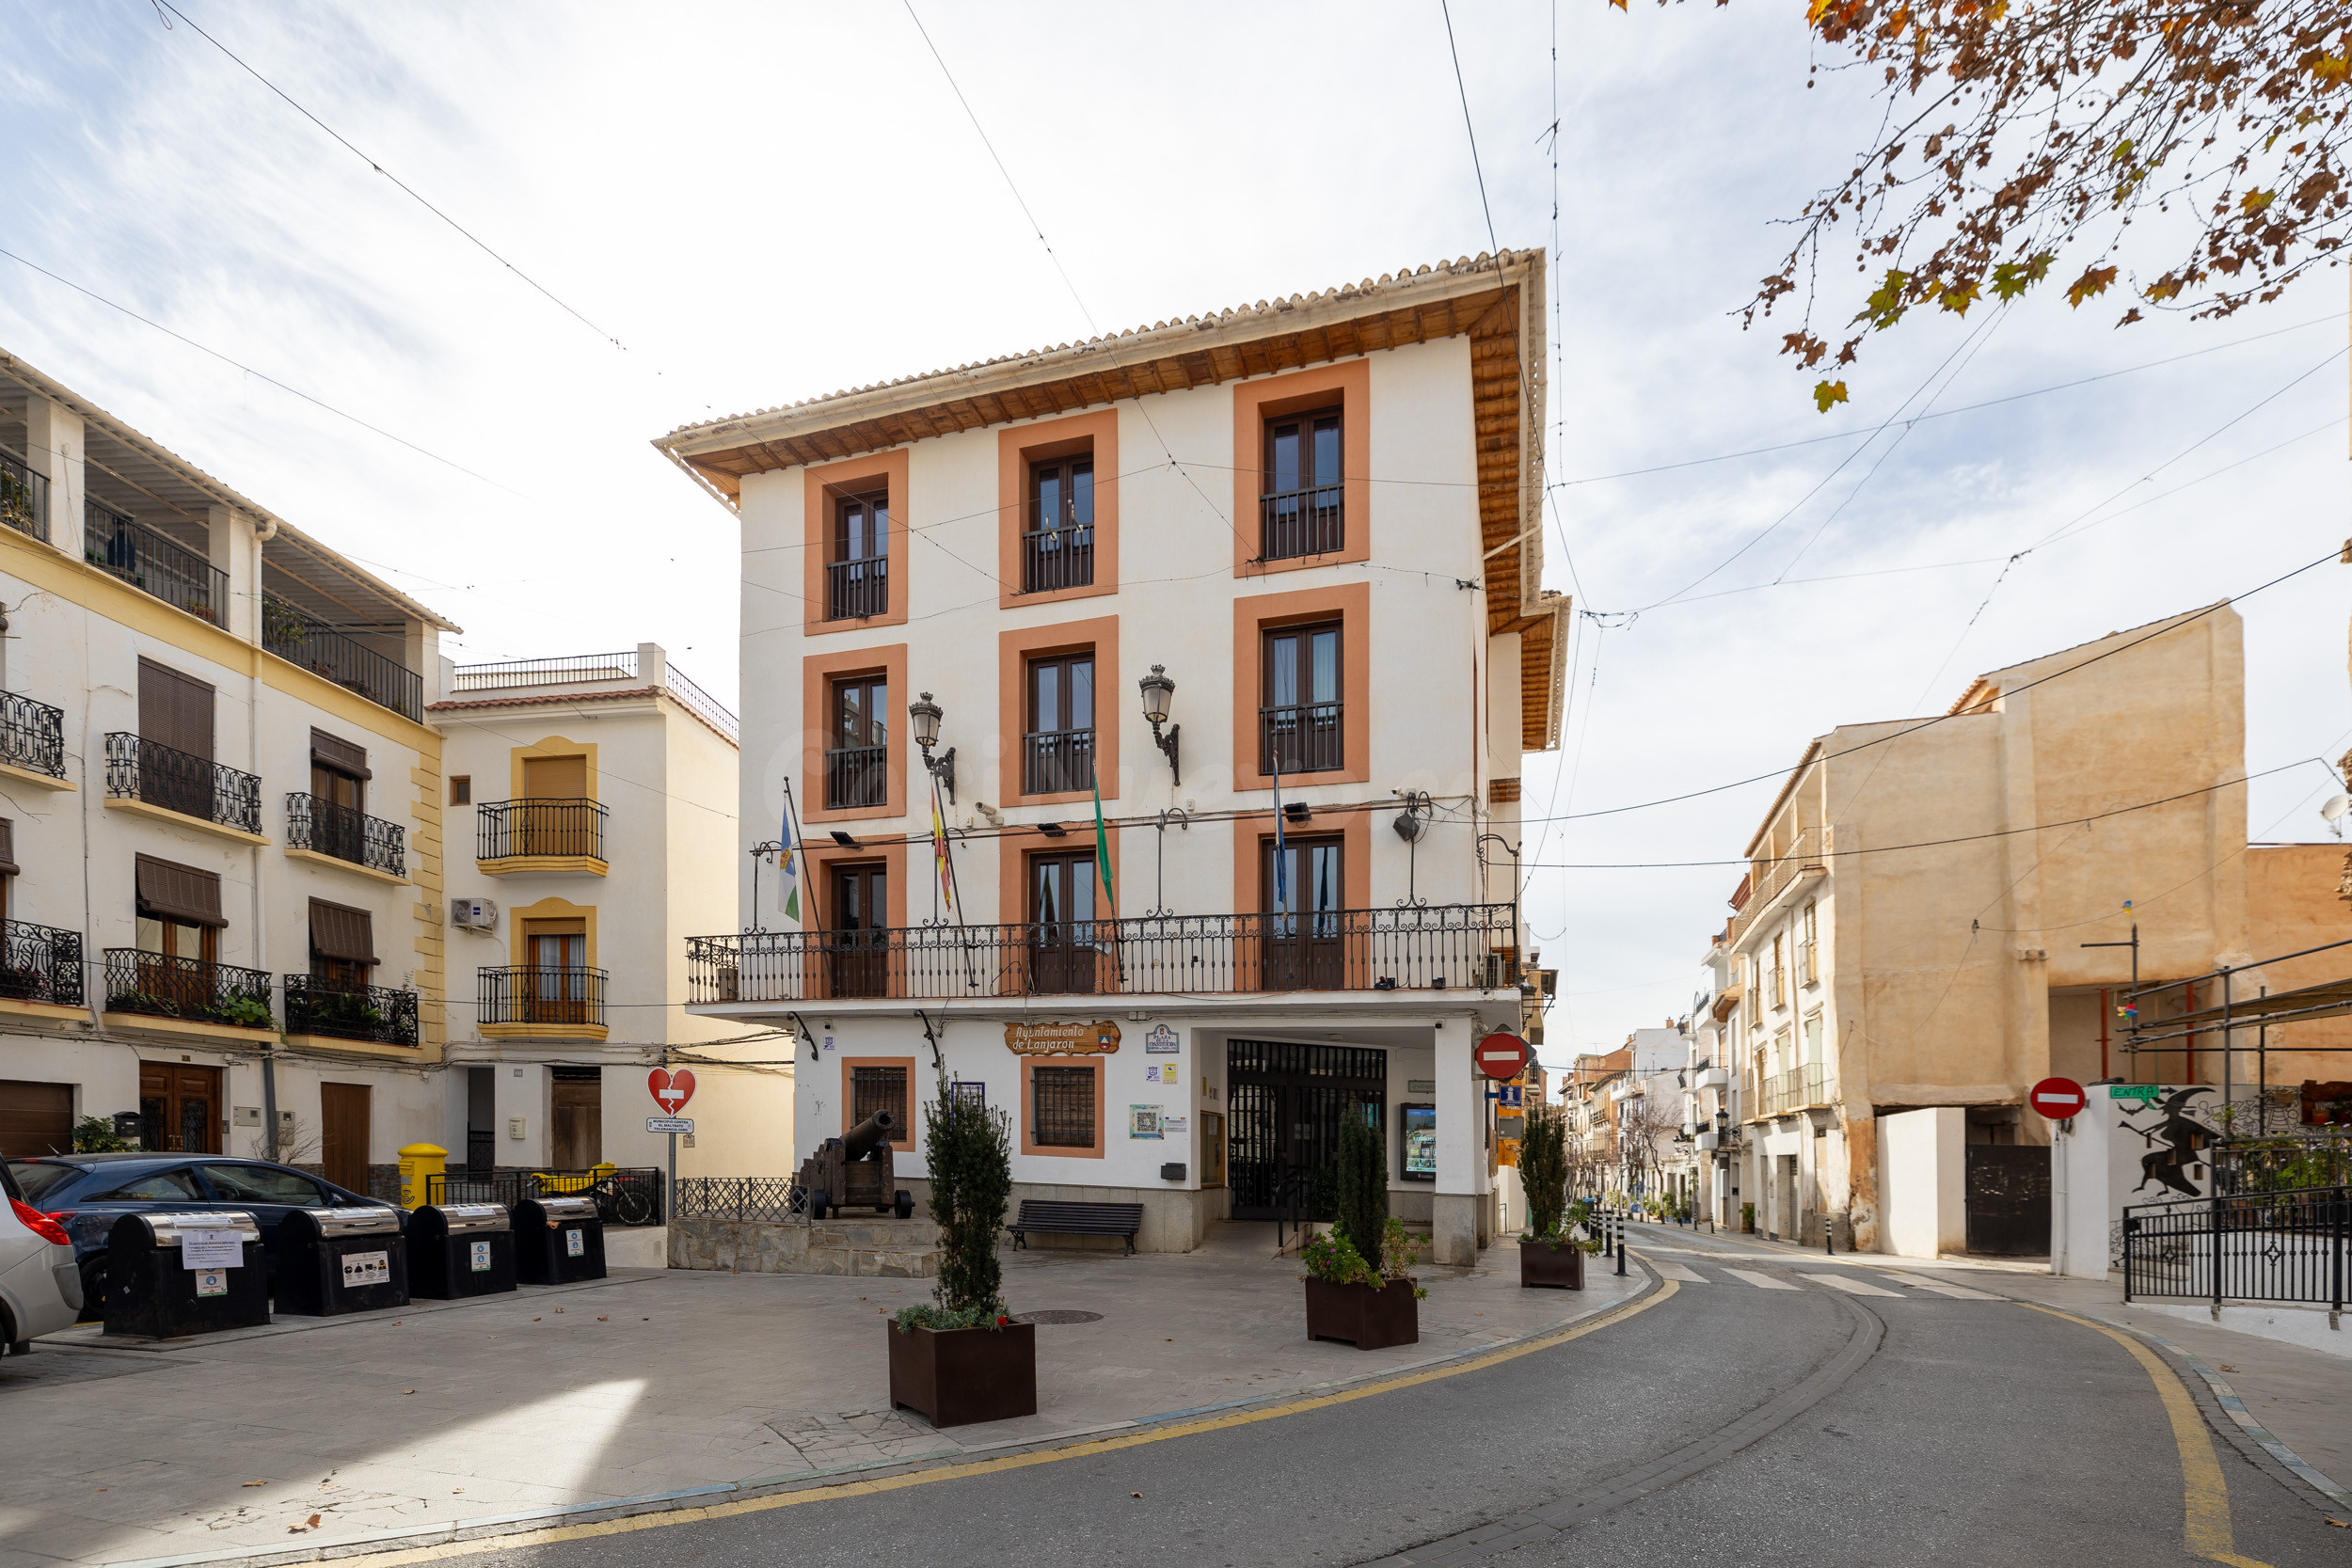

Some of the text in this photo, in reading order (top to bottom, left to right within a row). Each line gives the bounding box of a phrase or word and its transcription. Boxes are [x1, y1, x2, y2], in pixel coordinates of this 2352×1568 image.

[1016, 1025, 1084, 1041] Ayuntamiento
[1012, 1039, 1024, 1050] de
[2114, 1086, 2154, 1097] ENTRA
